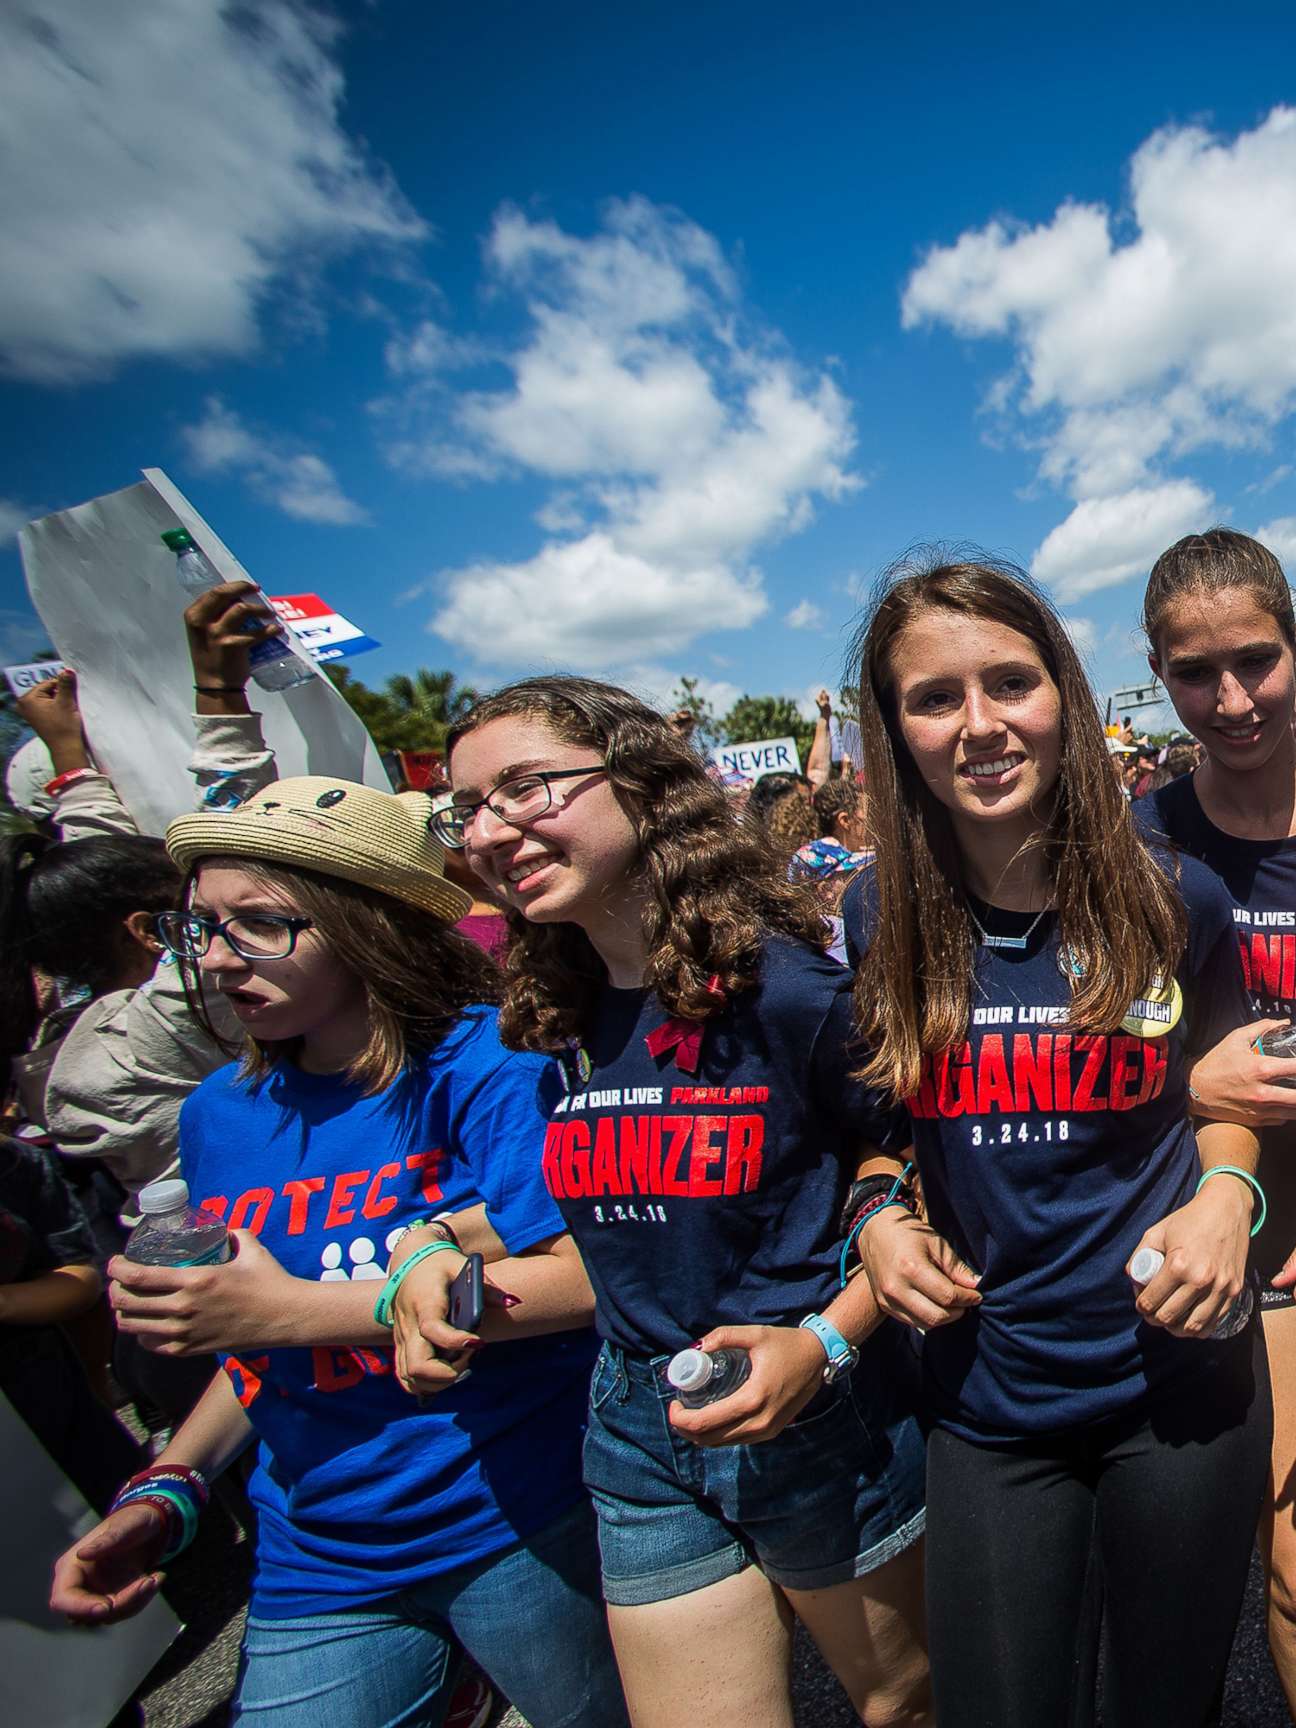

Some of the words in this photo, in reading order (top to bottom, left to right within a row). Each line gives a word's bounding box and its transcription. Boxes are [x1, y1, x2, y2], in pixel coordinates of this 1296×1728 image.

[722, 745, 792, 771] NEVER
[1253, 911, 1296, 927] LIVES
[973, 1006, 1014, 1025] OUR
[1017, 1006, 1071, 1024] LIVES
[1128, 1000, 1171, 1022] NOUGH
[588, 1089, 622, 1109] OUR
[624, 1087, 664, 1106] LIVES
[669, 1086, 770, 1105] PARKLAND
[971, 1119, 1070, 1146] 3.24.18
[593, 1204, 668, 1223] 3.24.18
